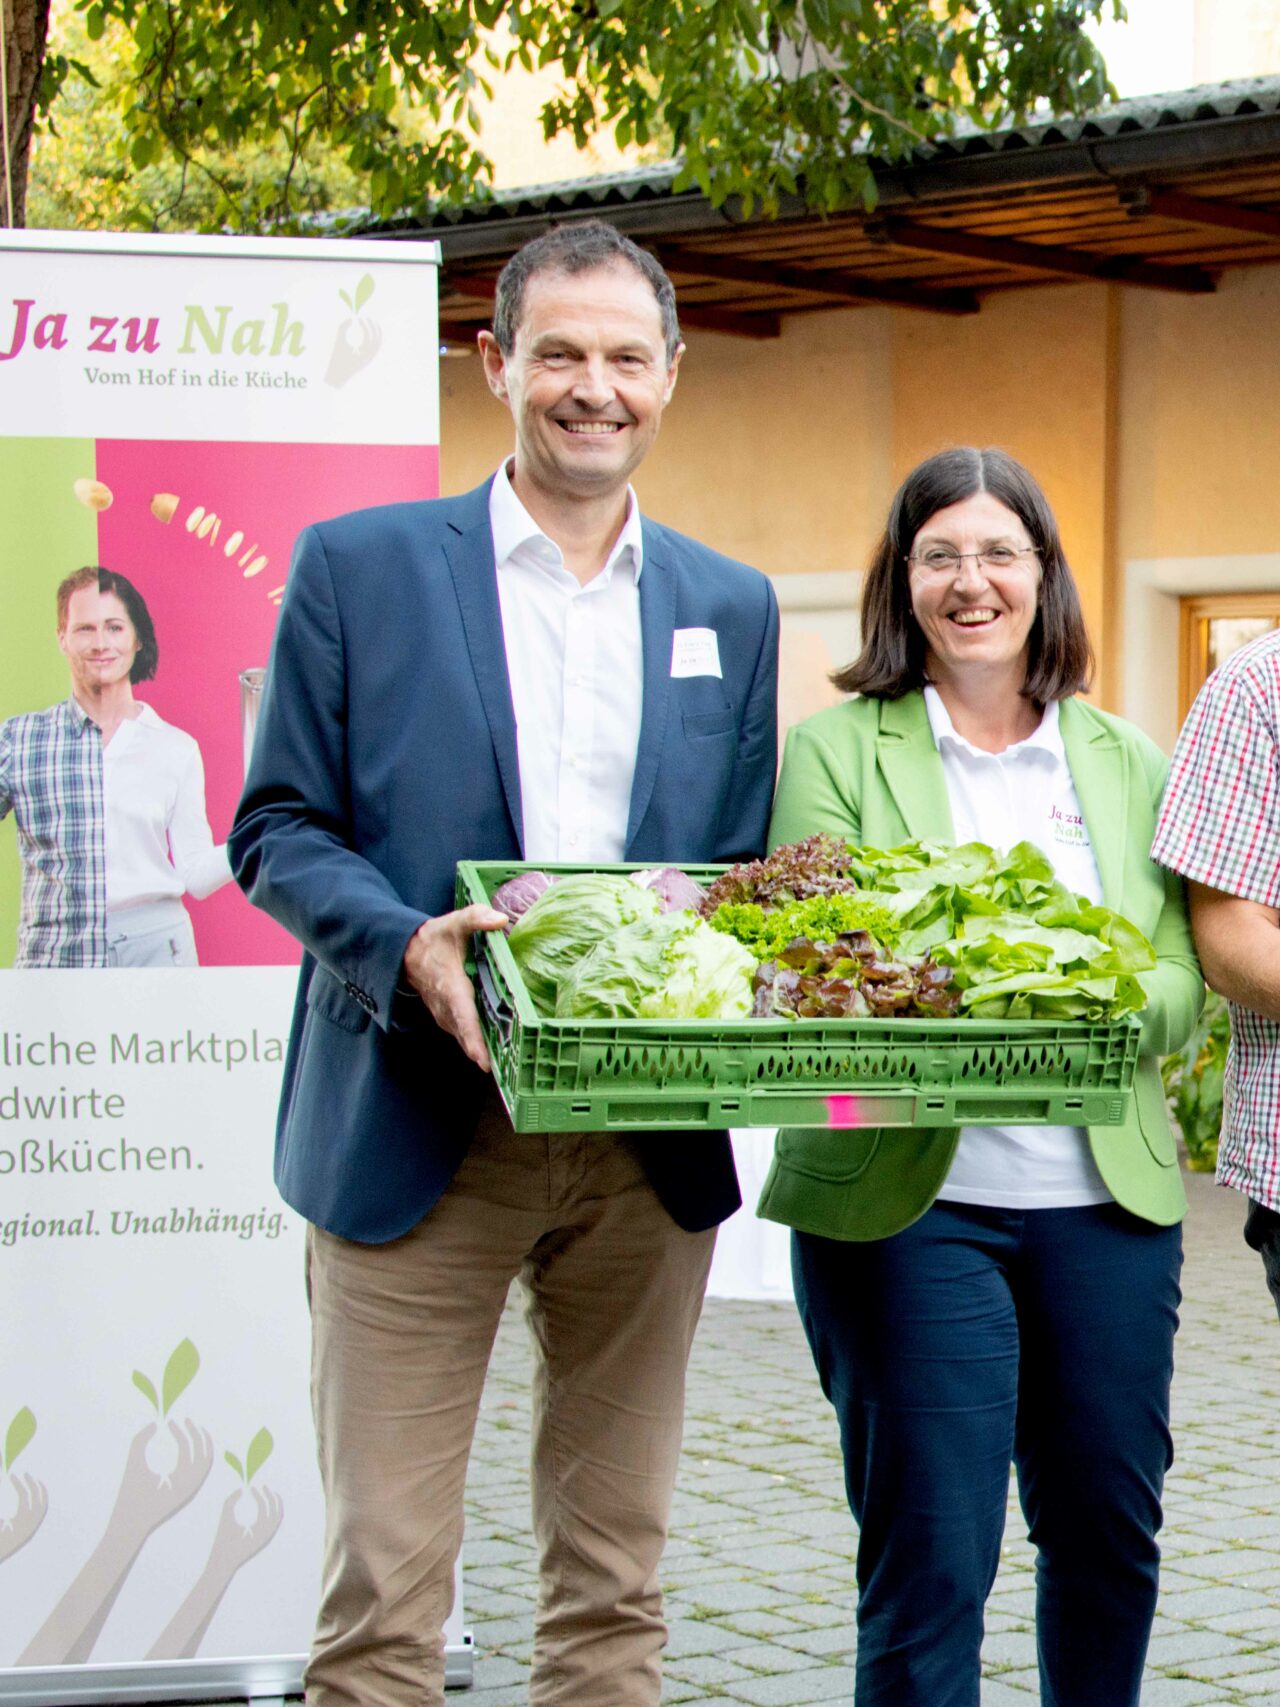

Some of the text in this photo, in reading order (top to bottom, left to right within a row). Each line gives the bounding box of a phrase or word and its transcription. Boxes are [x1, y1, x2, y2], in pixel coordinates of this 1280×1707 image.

[0, 299, 307, 361] Ja zu Nah
[84, 367, 308, 389] Vom Hof in die Küche
[1048, 804, 1083, 825] Ja zu
[1055, 823, 1083, 839] Nah
[3, 1029, 289, 1072] liche Marktpla
[0, 1086, 126, 1120] dwirte
[110, 1207, 289, 1240] Unabhängig.
